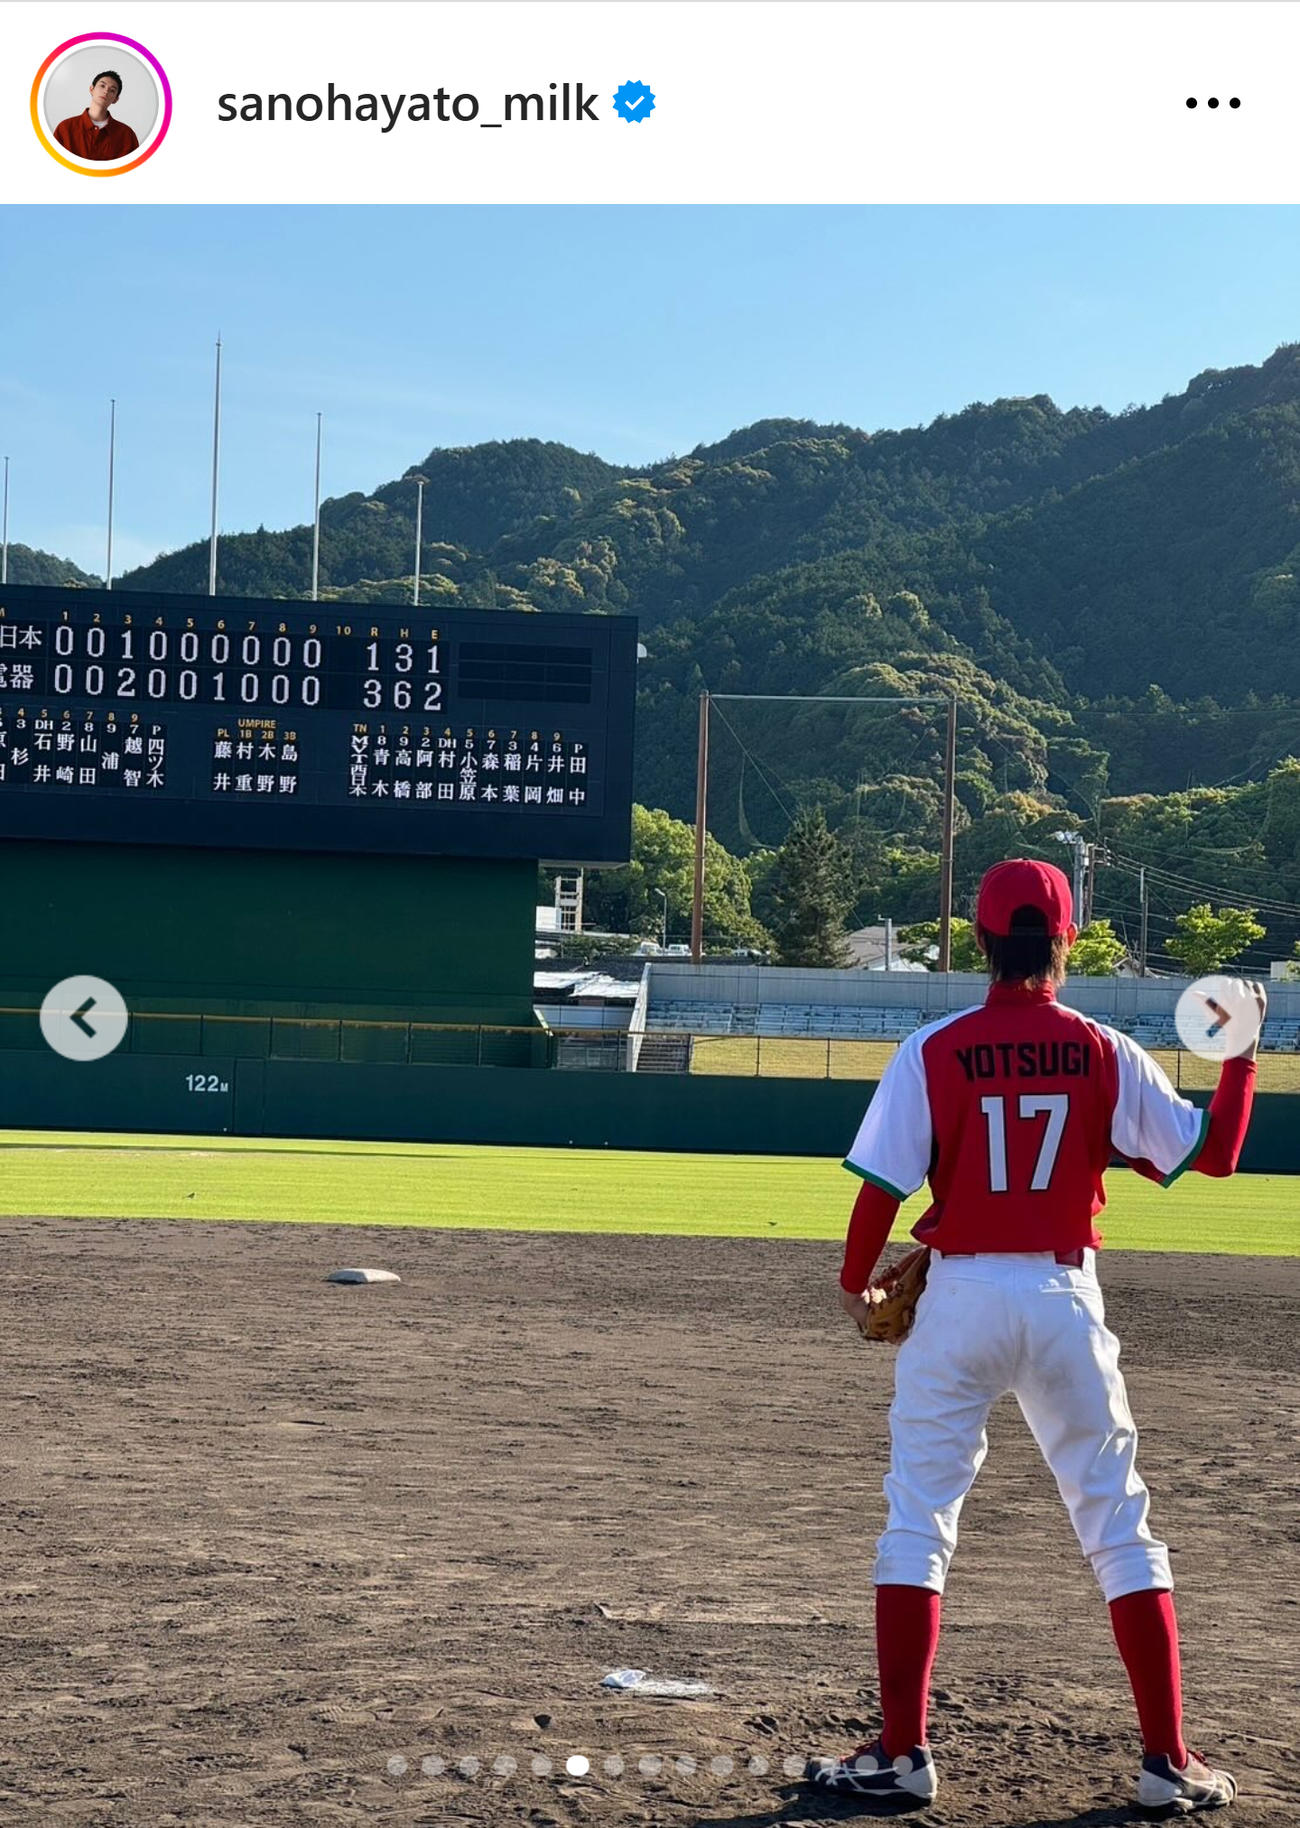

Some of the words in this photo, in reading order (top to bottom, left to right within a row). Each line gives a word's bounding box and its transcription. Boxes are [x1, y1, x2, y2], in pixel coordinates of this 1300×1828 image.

[62, 611, 68, 621] 1
[93, 613, 101, 623] 2
[124, 614, 132, 625] 3
[155, 616, 163, 626] 4
[186, 617, 194, 628] 5
[217, 619, 225, 630] 6
[248, 621, 256, 631] 7
[278, 622, 286, 633] 8
[309, 623, 317, 634] 9
[335, 625, 352, 636] 10
[370, 626, 379, 637] R
[400, 628, 409, 638] H
[431, 629, 438, 640] E
[56, 626, 73, 655] 0
[87, 628, 104, 657] 0
[122, 630, 133, 658] 1
[150, 631, 167, 660] 0
[181, 633, 198, 662] 0
[212, 634, 229, 663] 0
[243, 636, 259, 665] 0
[273, 637, 290, 666] 0
[304, 639, 321, 668] 0
[367, 643, 379, 670] 1
[395, 644, 412, 672] 3
[428, 646, 439, 673] 1
[55, 664, 72, 693] 0
[86, 665, 103, 695] 0
[117, 668, 135, 696] 2
[149, 669, 165, 698] 0
[179, 670, 197, 699] 0
[213, 673, 225, 700] 1
[241, 674, 258, 702] 0
[272, 675, 289, 704] 0
[302, 676, 319, 705] 0
[364, 680, 381, 707] 3
[394, 681, 411, 709] 6
[424, 682, 441, 710] 2
[34, 719, 54, 731] DH
[217, 727, 230, 738] PL
[240, 729, 252, 739] 1B
[261, 730, 275, 740] 2B
[283, 731, 297, 741] 3B
[237, 718, 277, 729] UMPIRE
[956, 1042, 1090, 1081] YOTSUGI
[981, 1094, 1069, 1193] 17
